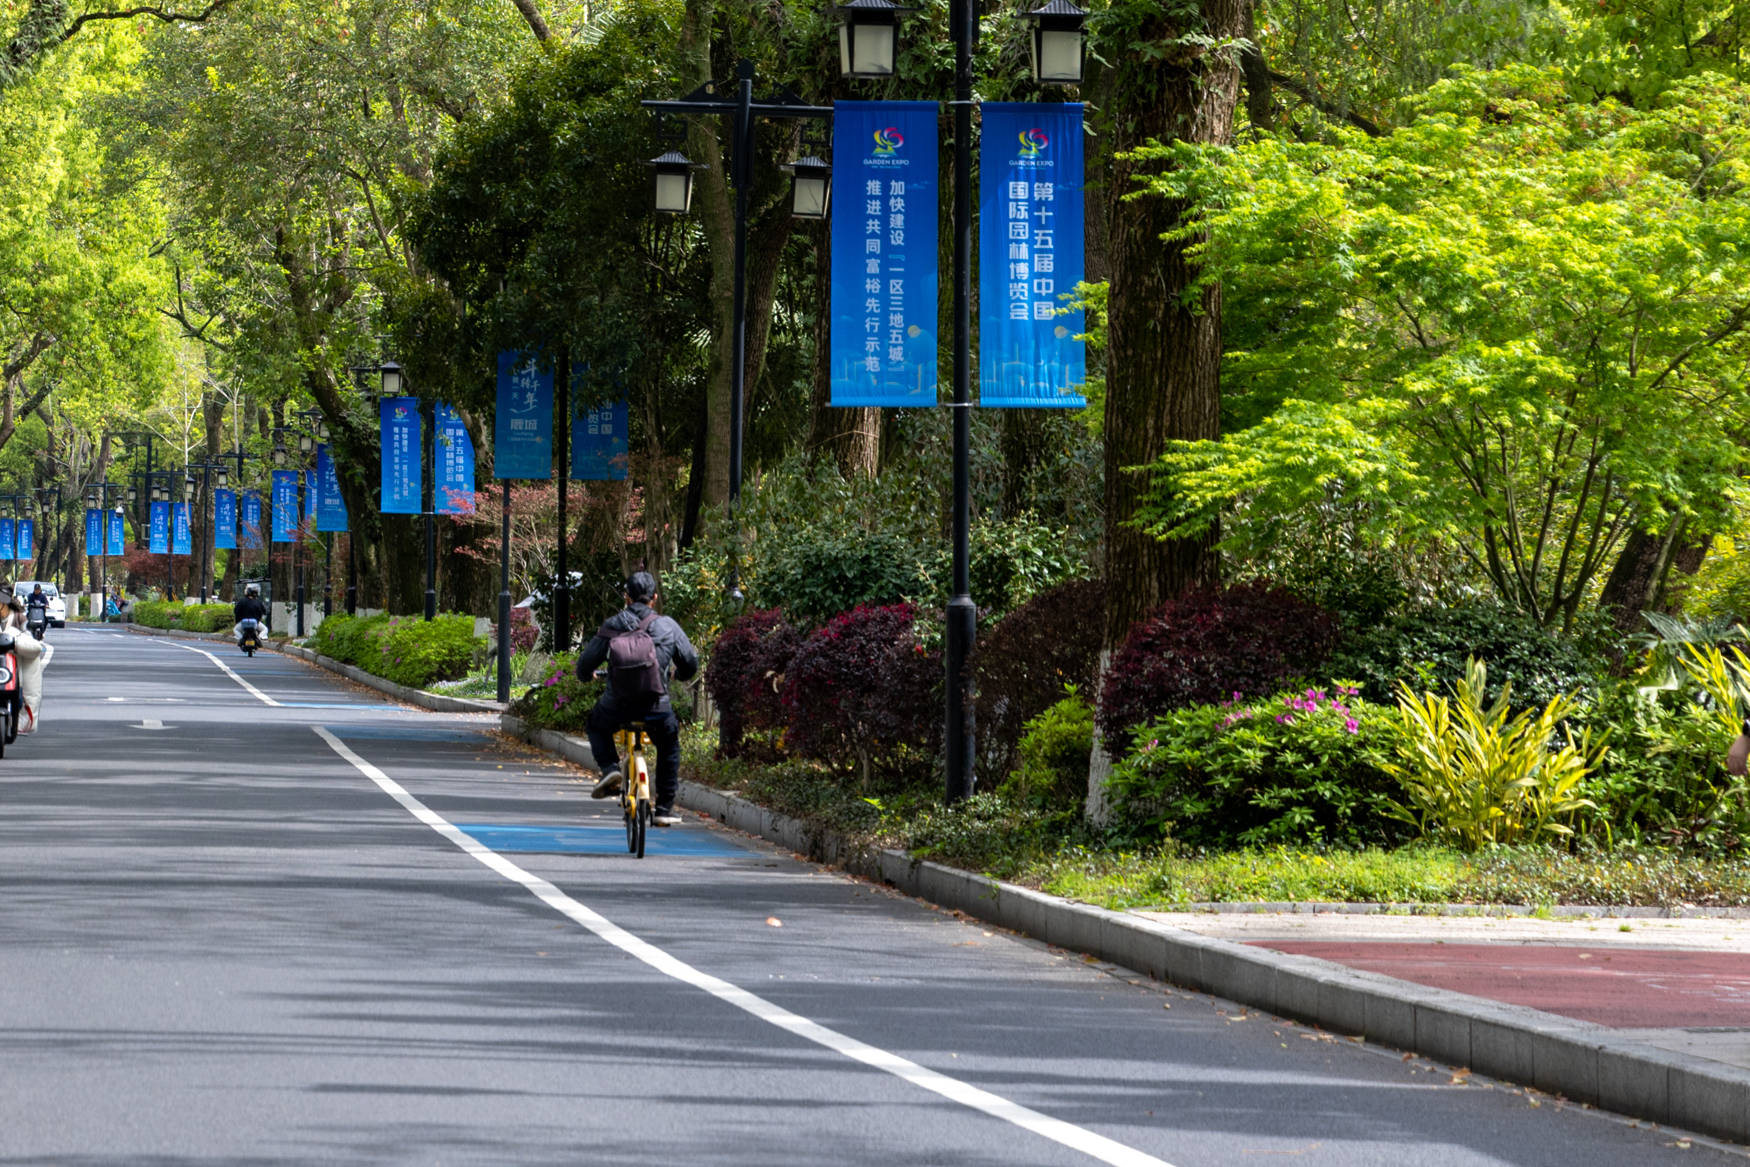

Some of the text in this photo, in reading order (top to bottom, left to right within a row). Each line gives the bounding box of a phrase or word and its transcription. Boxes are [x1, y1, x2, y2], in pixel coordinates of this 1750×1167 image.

[864, 179, 882, 372] 推进共同富裕先行示范
[1008, 181, 1029, 321] 国际园林博览会
[1033, 182, 1054, 321] 第十五届中国
